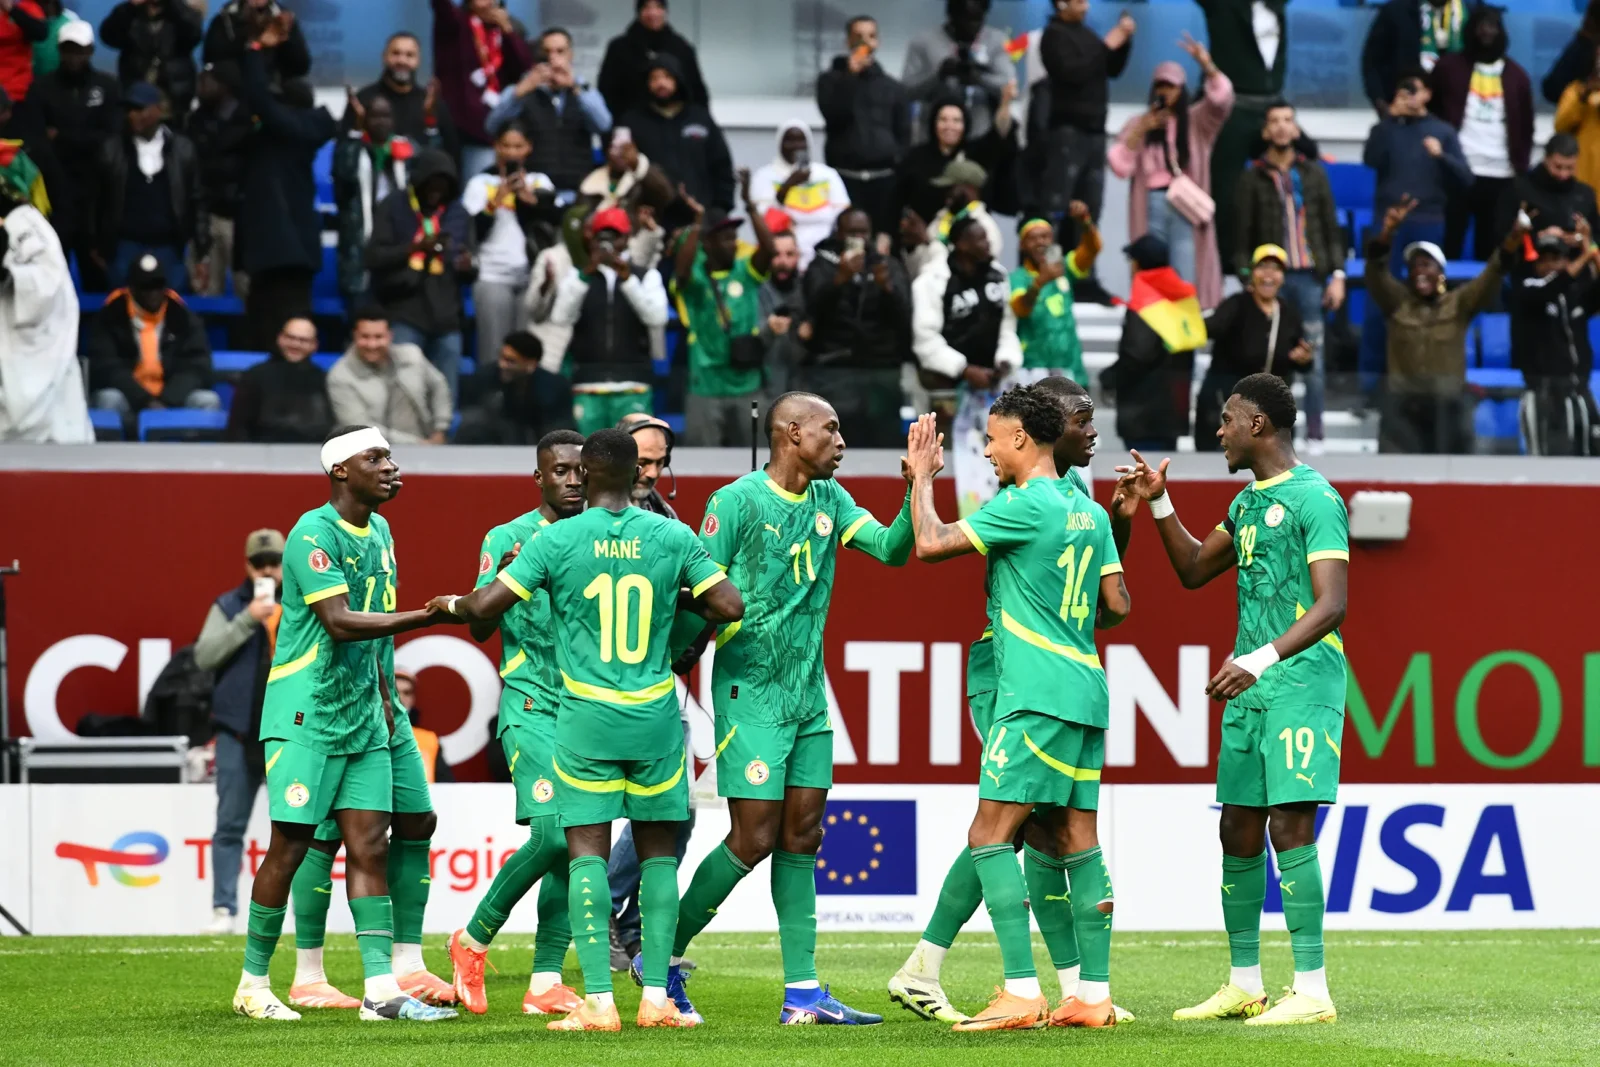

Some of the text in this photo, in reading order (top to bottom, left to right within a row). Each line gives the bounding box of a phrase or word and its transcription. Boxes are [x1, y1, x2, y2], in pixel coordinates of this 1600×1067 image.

[594, 535, 642, 559] MANÉ
[790, 539, 816, 585] 11
[1238, 524, 1257, 567] 19
[1057, 544, 1094, 631] 14
[583, 572, 654, 665] 10
[1346, 650, 1600, 770] MO
[1278, 726, 1315, 770] 19
